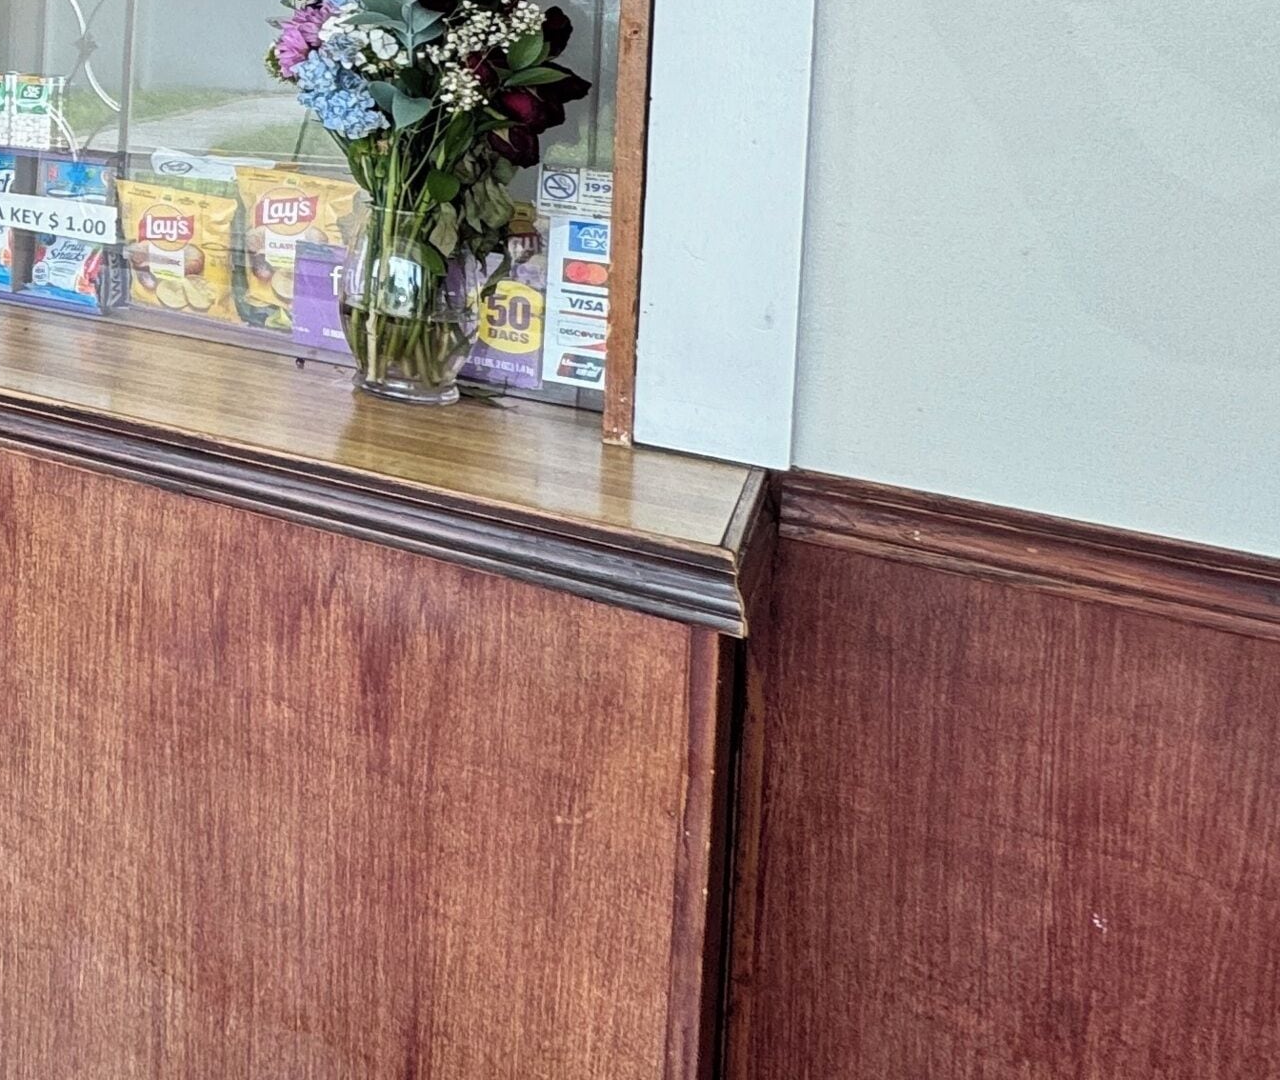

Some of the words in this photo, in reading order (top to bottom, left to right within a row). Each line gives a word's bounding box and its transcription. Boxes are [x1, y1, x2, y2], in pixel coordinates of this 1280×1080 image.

[10, 206, 43, 226] KEY
[48, 212, 59, 230] $
[66, 216, 107, 236] 1.00
[262, 197, 312, 226] Lay's
[146, 214, 190, 241] Lay's
[577, 226, 607, 239] AM
[582, 238, 606, 251] EX
[486, 293, 532, 331] 50
[567, 297, 604, 313] VISA
[487, 326, 531, 344] BAGS
